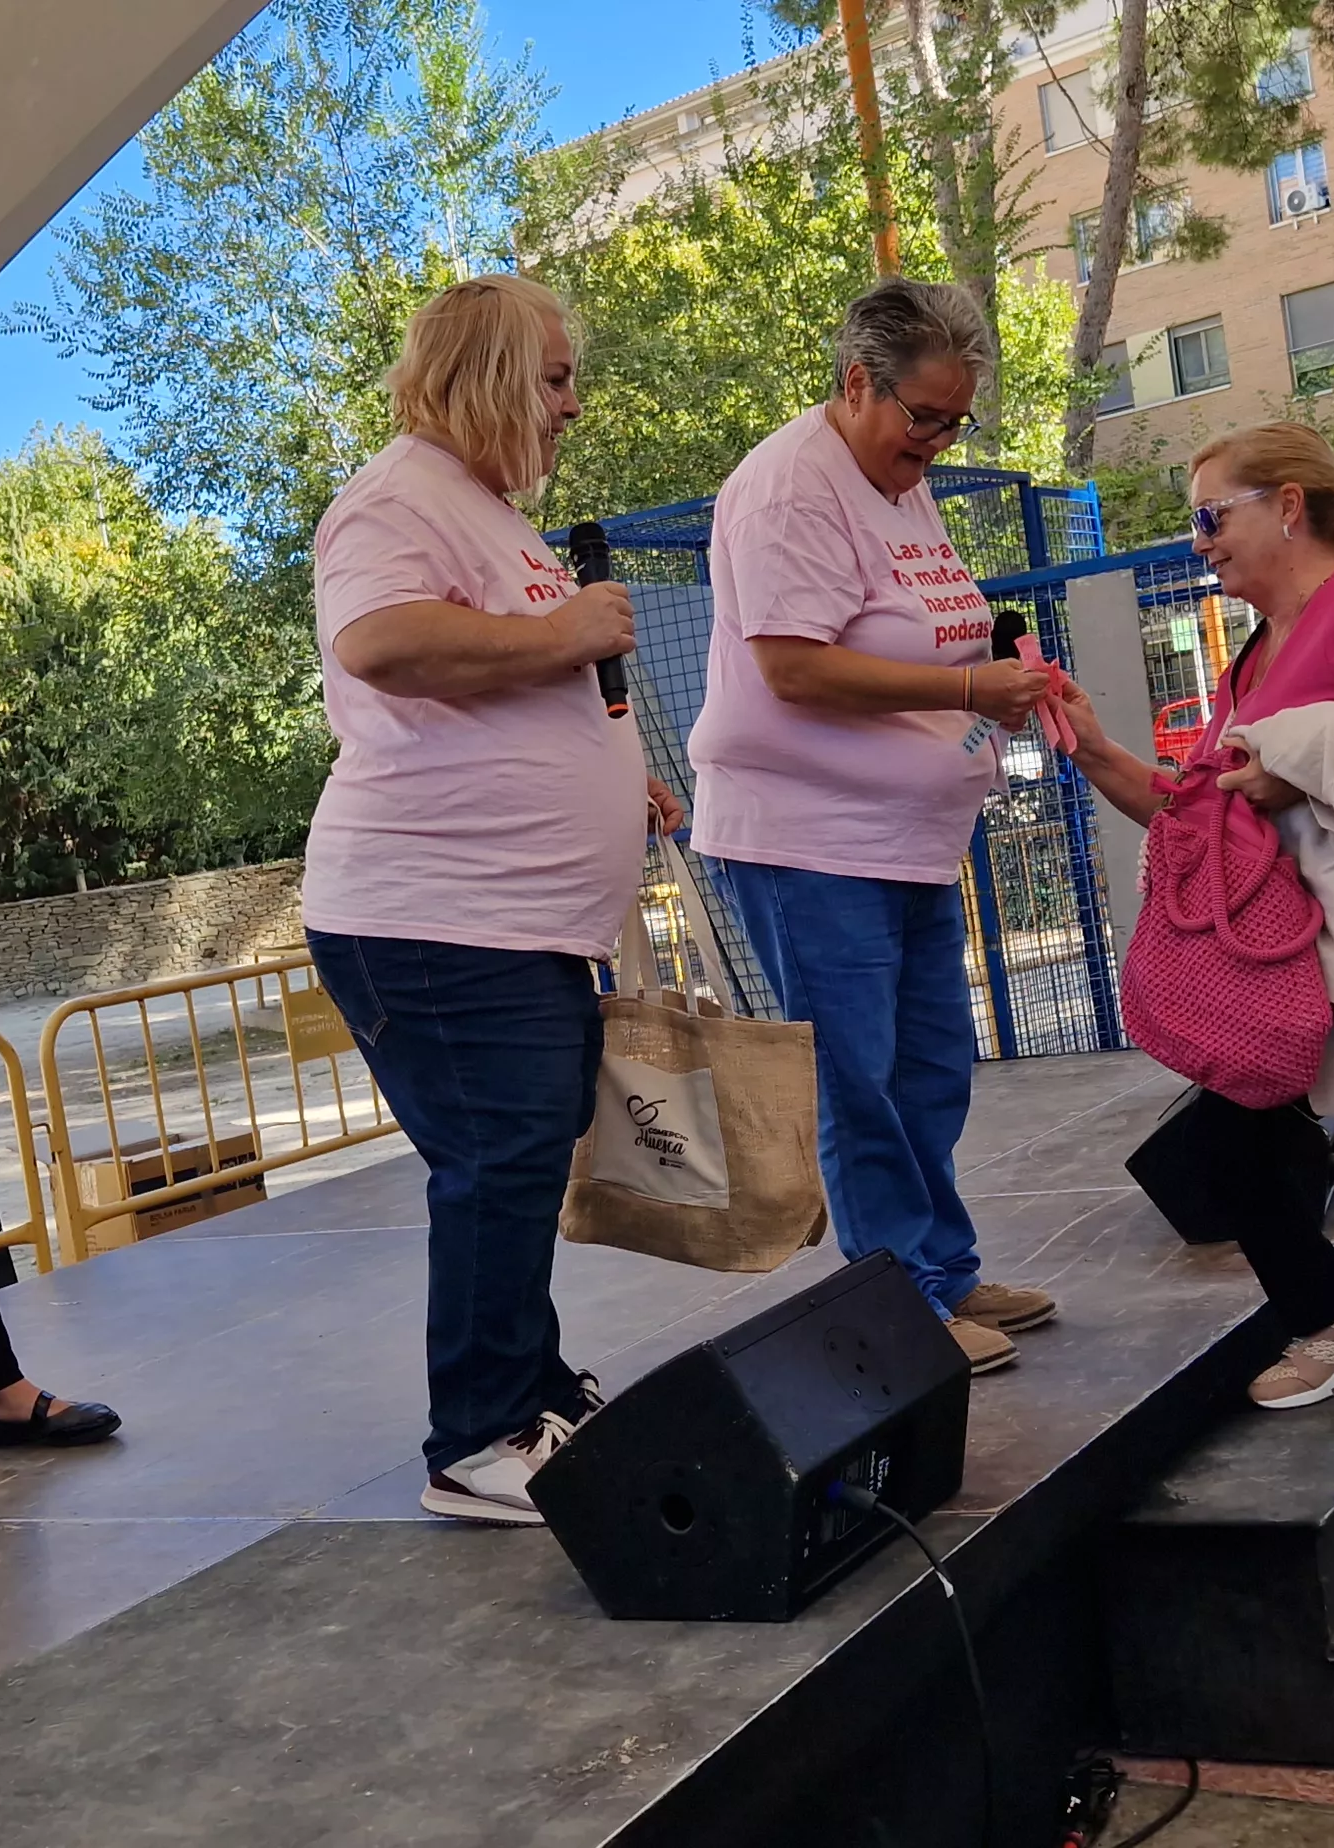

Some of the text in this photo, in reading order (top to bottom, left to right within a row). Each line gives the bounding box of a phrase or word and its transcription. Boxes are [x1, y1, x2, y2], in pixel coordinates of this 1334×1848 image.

[885, 541, 923, 561] Las
[935, 618, 992, 649] podcas
[634, 1128, 686, 1155] Huesca
[648, 1127, 689, 1141] COMERCIO
